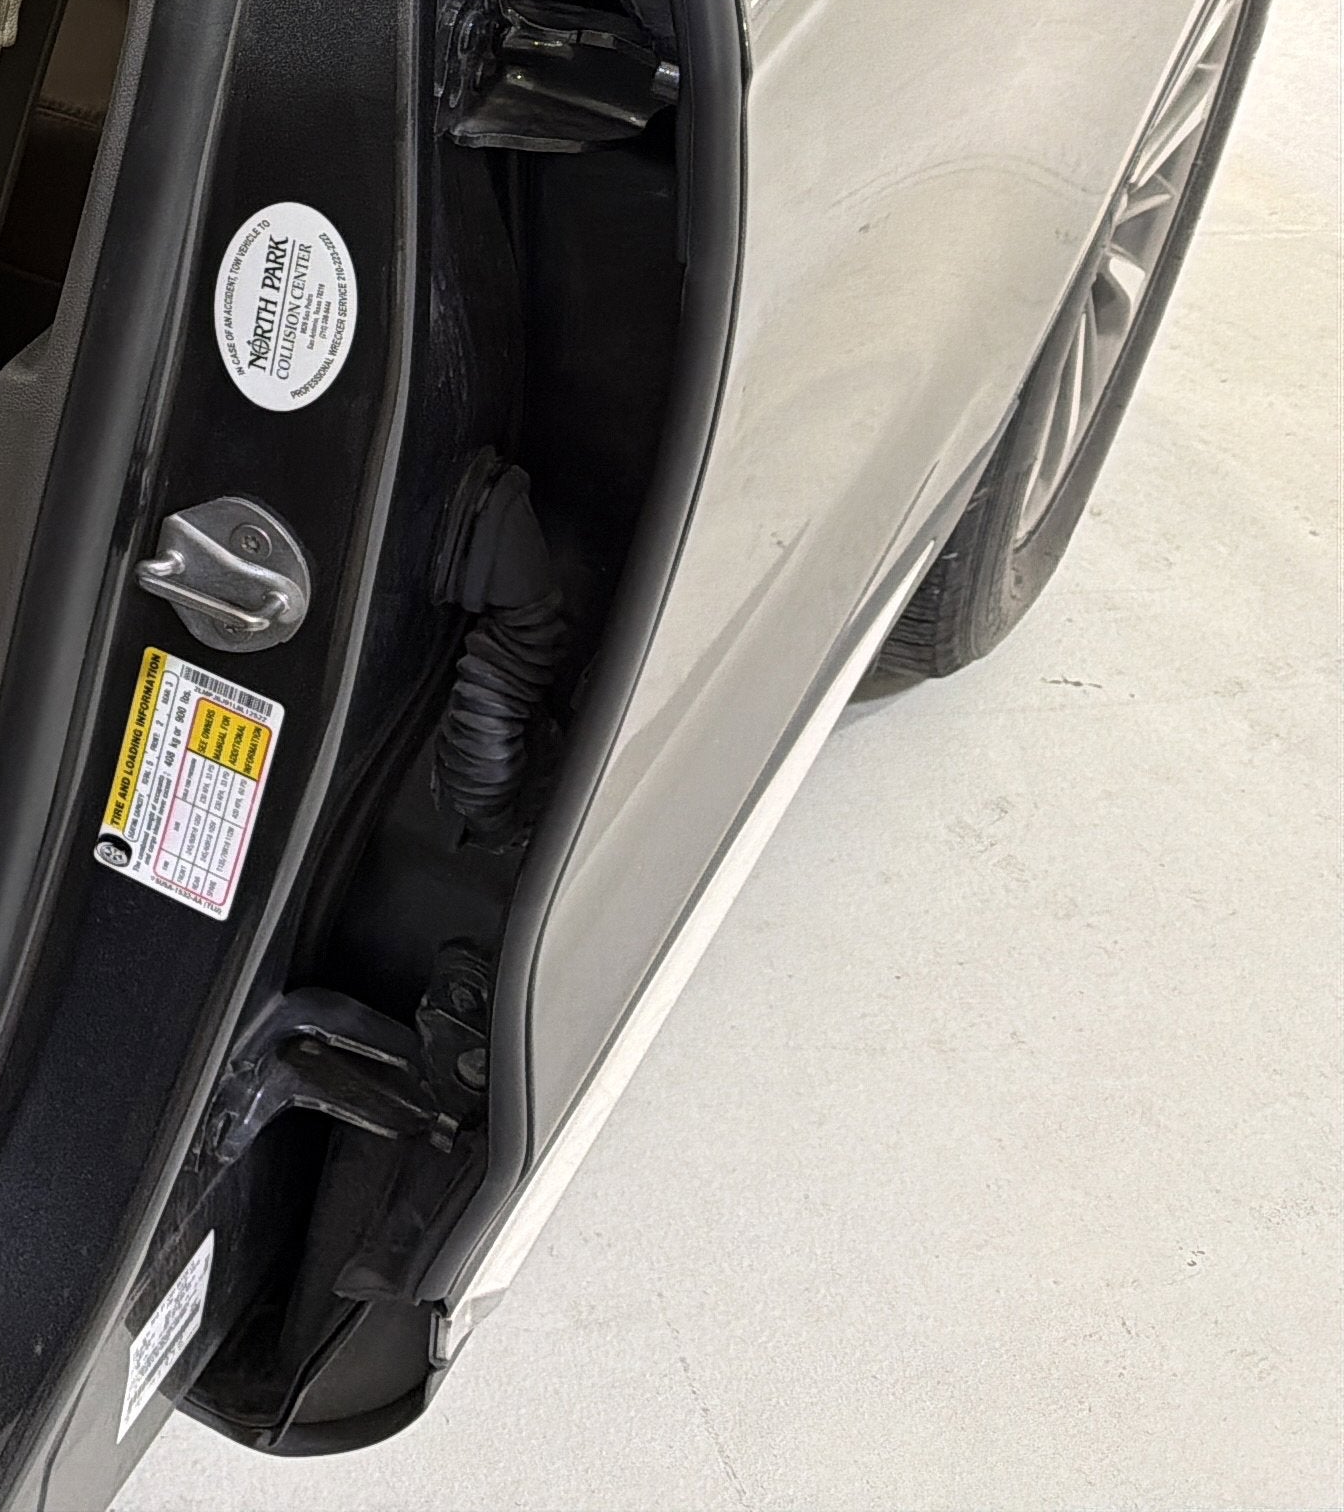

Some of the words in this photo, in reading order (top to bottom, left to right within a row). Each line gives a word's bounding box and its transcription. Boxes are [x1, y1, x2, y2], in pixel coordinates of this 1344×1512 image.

[256, 218, 270, 230] TO
[235, 226, 261, 256] VEHICLE
[229, 255, 242, 275] TOW
[260, 233, 289, 293] PARK
[223, 274, 239, 316] ACCIDENT,
[224, 315, 232, 329] AN
[274, 301, 302, 380] COLLISION
[289, 242, 312, 301] CENTER
[224, 328, 234, 340] OF
[246, 296, 278, 372] NORTH
[289, 356, 333, 399] PROFESSIONAL
[327, 317, 345, 356] WRECKER
[337, 282, 348, 317] SERVICE
[227, 342, 240, 364] CASE
[236, 366, 245, 375] IN
[133, 652, 162, 727] INFORMATION
[173, 704, 187, 724] 900
[219, 714, 231, 731] FOR
[172, 725, 182, 737] or
[121, 727, 143, 776] LOADING
[168, 736, 181, 749] kg
[162, 749, 175, 767] 408
[116, 775, 131, 800] AND
[109, 800, 125, 826] TIRE
